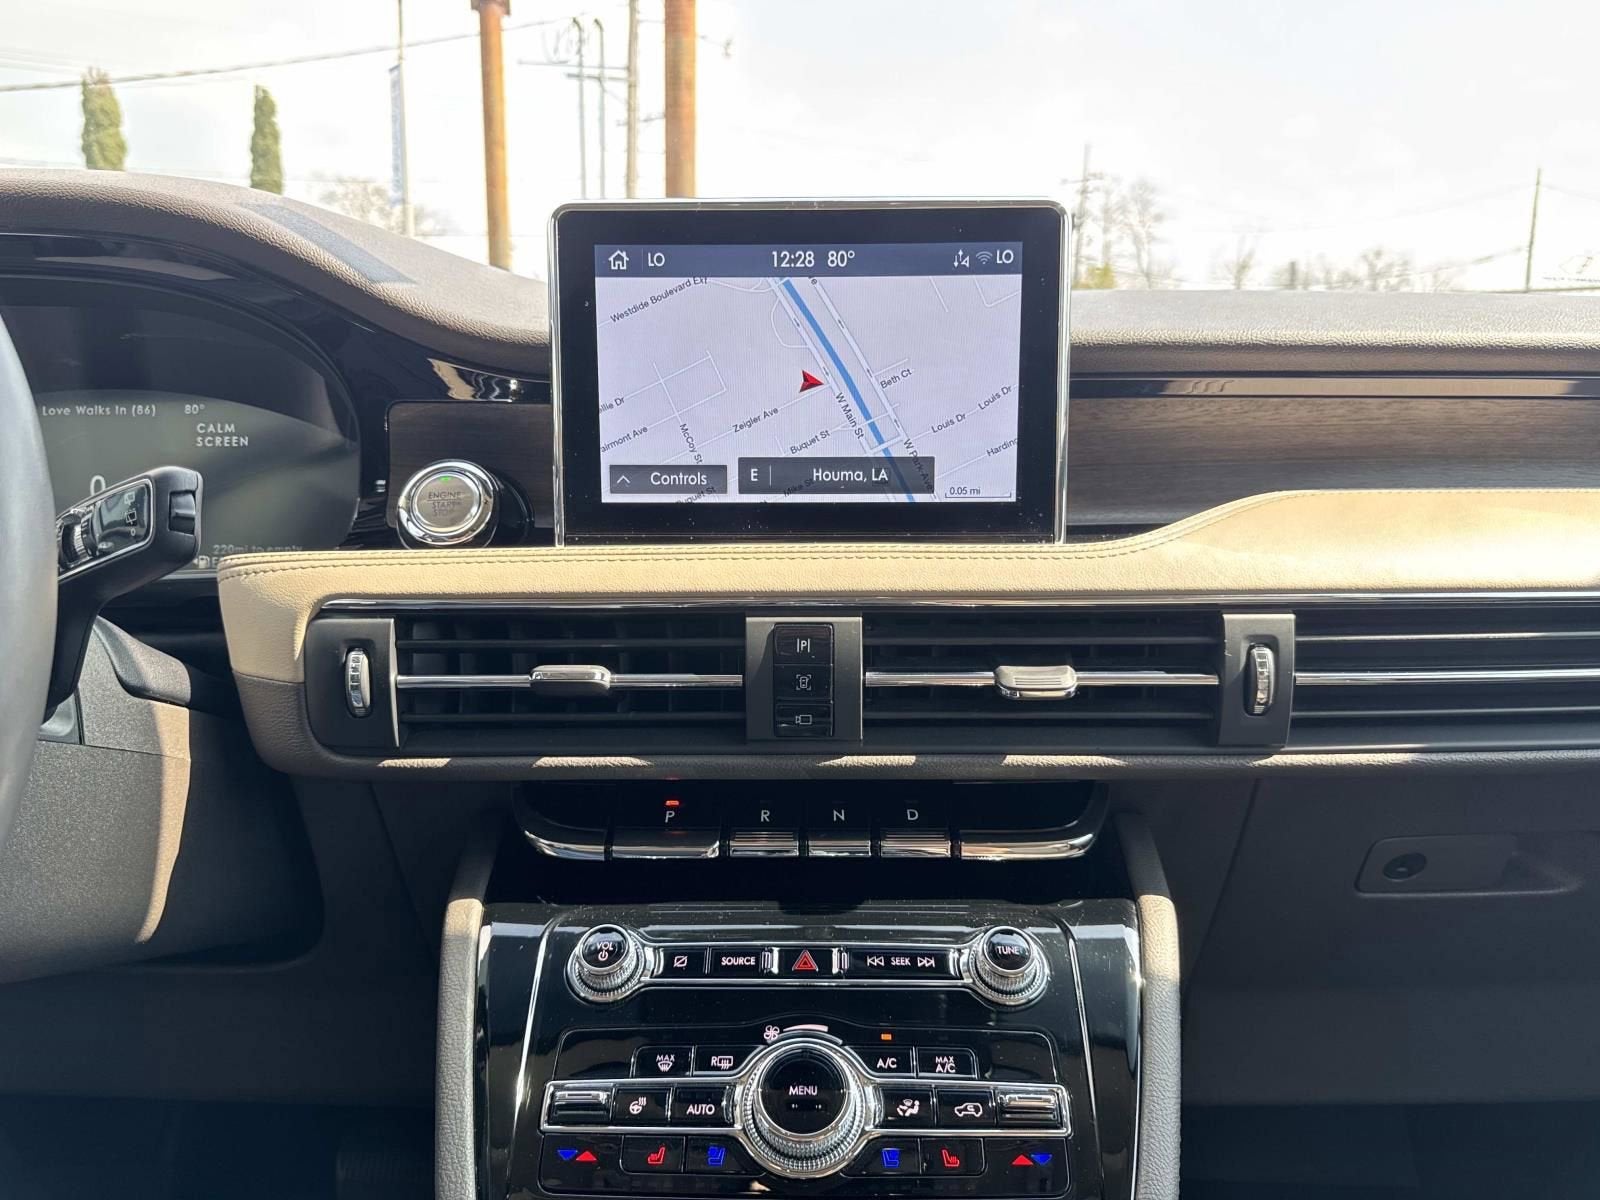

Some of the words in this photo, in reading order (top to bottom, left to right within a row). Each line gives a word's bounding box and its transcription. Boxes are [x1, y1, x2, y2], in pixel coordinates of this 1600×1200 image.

[648, 252, 665, 267] LO
[771, 251, 815, 268] 12:28
[827, 250, 855, 268] 80°
[996, 249, 1014, 264] LO
[649, 279, 692, 305] Boulevard
[880, 374, 900, 389] Beth
[901, 368, 912, 378] Ct
[614, 397, 625, 406] Dr
[978, 393, 1001, 410] Louis
[1001, 385, 1012, 395] Dr
[42, 405, 71, 416] Love
[75, 405, 111, 416] Walks
[115, 405, 127, 416] In
[131, 404, 157, 417] (86)
[184, 404, 205, 415] 80°
[836, 392, 846, 404] W
[842, 404, 857, 428] Main
[854, 427, 865, 439] St
[733, 414, 762, 433] Zeigler
[763, 407, 779, 420] Ave
[931, 418, 955, 433] Louis
[955, 412, 966, 423] Dr
[196, 423, 236, 434] CALM
[632, 427, 648, 438] Ave
[195, 436, 249, 447] SCREEN
[680, 423, 698, 453] McCoy
[694, 453, 703, 464] St
[790, 434, 819, 455] Buquet
[819, 429, 830, 440] St
[904, 438, 914, 449] W
[650, 472, 708, 486] Controls
[751, 469, 758, 481] E
[813, 468, 867, 483] Houma,
[872, 468, 888, 481] LA
[949, 487, 968, 496] 0.05
[969, 486, 981, 496] mi
[665, 811, 675, 822] P
[760, 810, 770, 822] R
[833, 810, 845, 822] N
[907, 809, 918, 821] D
[597, 942, 614, 951] VOL
[996, 945, 1019, 955] TUNE
[721, 956, 756, 966] SOURCE
[890, 957, 911, 966] SEEK
[656, 1054, 675, 1062] MAX
[877, 1057, 897, 1069] A/C
[935, 1055, 955, 1063] MAX
[936, 1063, 956, 1073] A/C
[789, 1085, 818, 1096] MENU
[686, 1105, 715, 1115] AUTO
